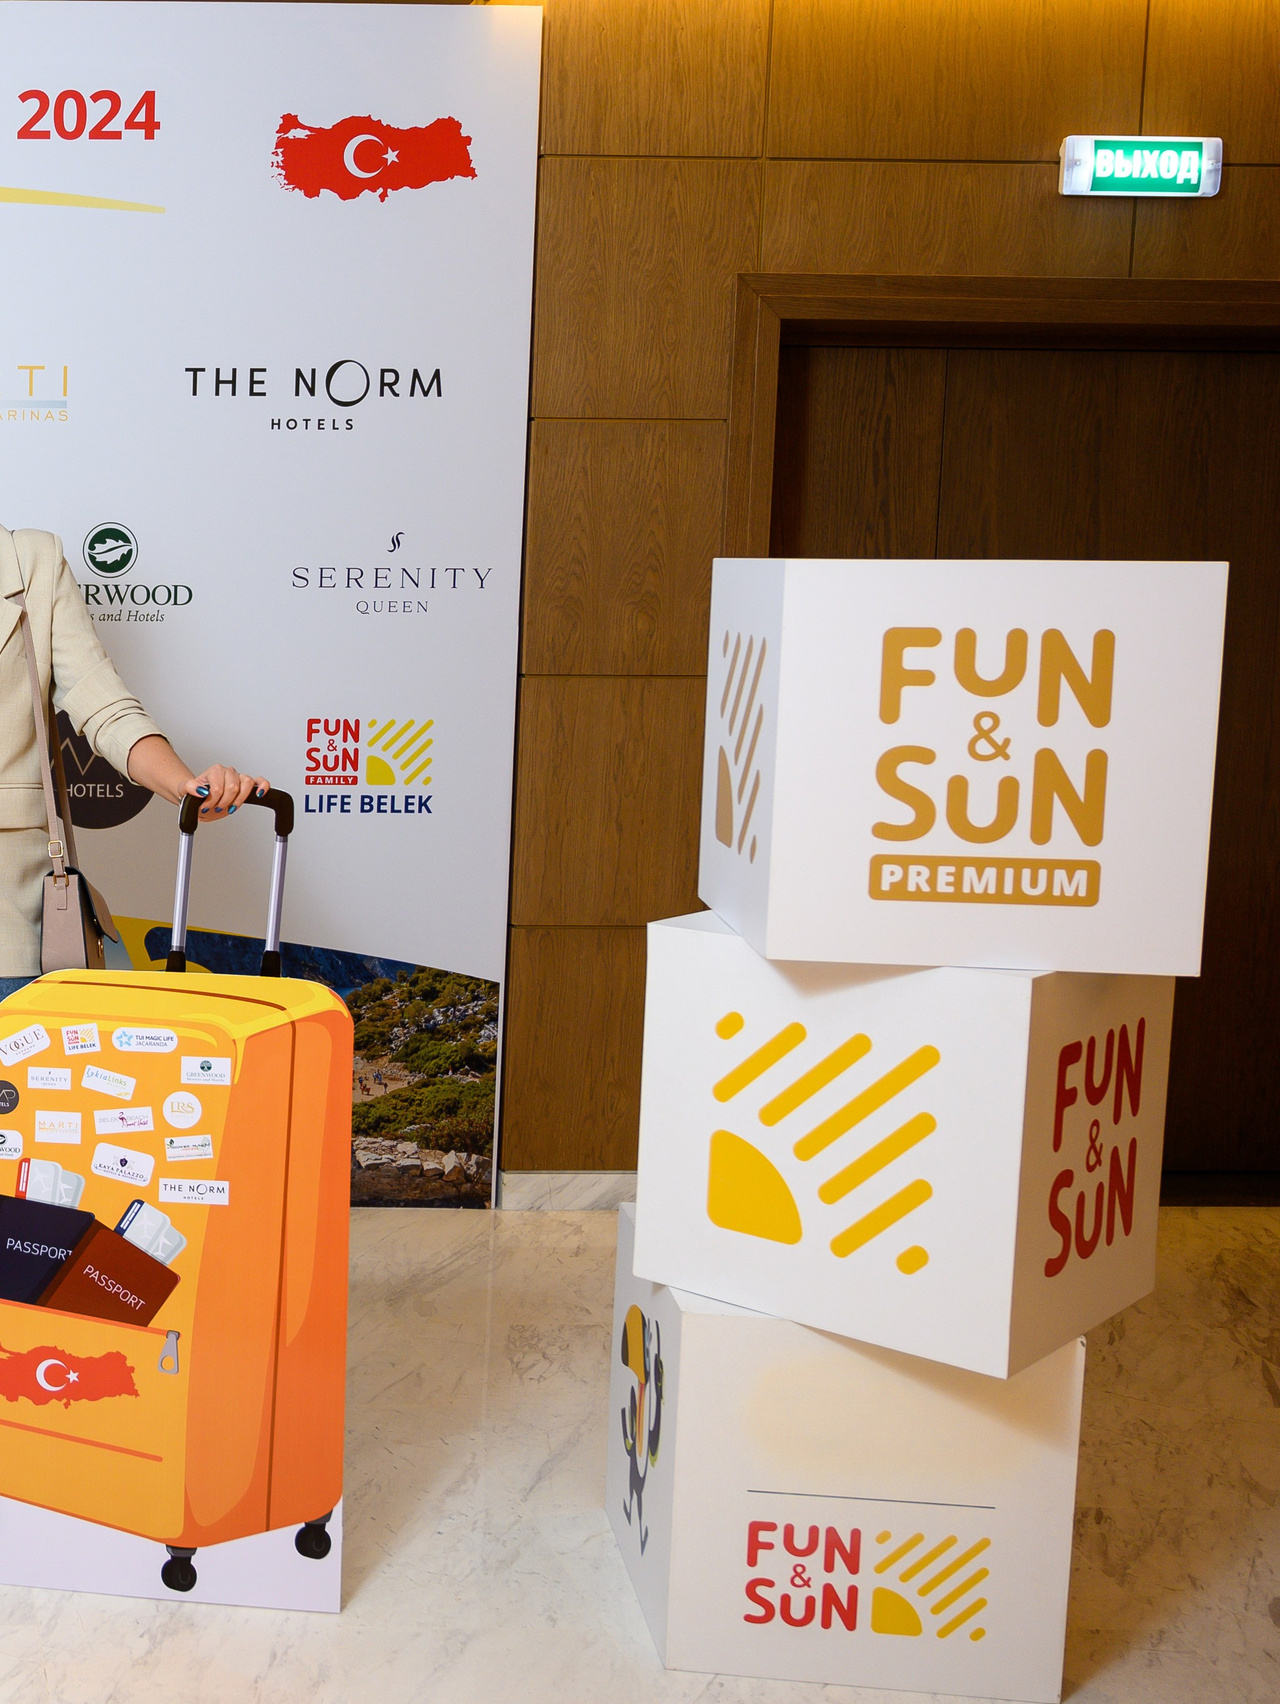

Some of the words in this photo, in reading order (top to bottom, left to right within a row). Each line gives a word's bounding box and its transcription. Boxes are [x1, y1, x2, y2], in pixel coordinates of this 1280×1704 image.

[17, 90, 160, 140] 2024
[1095, 149, 1199, 184] ВЫХОД
[185, 368, 266, 396] THE
[295, 360, 442, 407] NORM
[271, 419, 353, 430] HOTELS
[293, 567, 492, 589] SERENITY
[78, 584, 193, 605] RWOOD
[356, 601, 428, 614] QUEEN
[99, 610, 122, 621] and
[126, 610, 164, 621] Hotels
[879, 627, 1116, 728] FUN
[307, 719, 360, 743] FUN
[967, 711, 1011, 762] &
[327, 739, 337, 751] &
[306, 748, 359, 772] SUN
[305, 795, 351, 813] LIFE
[360, 795, 432, 813] BELEK
[872, 745, 1109, 846] SUN
[881, 864, 1087, 897] PREMIUM
[0, 1029, 44, 1055] VOGUE
[1052, 1017, 1145, 1152] FUN
[171, 1102, 194, 1113] LRS
[1085, 1118, 1103, 1173] &
[116, 1169, 144, 1179] PALAZZO
[163, 1184, 183, 1192] THE
[189, 1184, 225, 1195] NORM
[1044, 1137, 1137, 1278] SUN
[83, 1265, 145, 1310] PASSPORT
[746, 1521, 861, 1575] FUN
[790, 1564, 812, 1588] &
[743, 1578, 858, 1631] SUN
